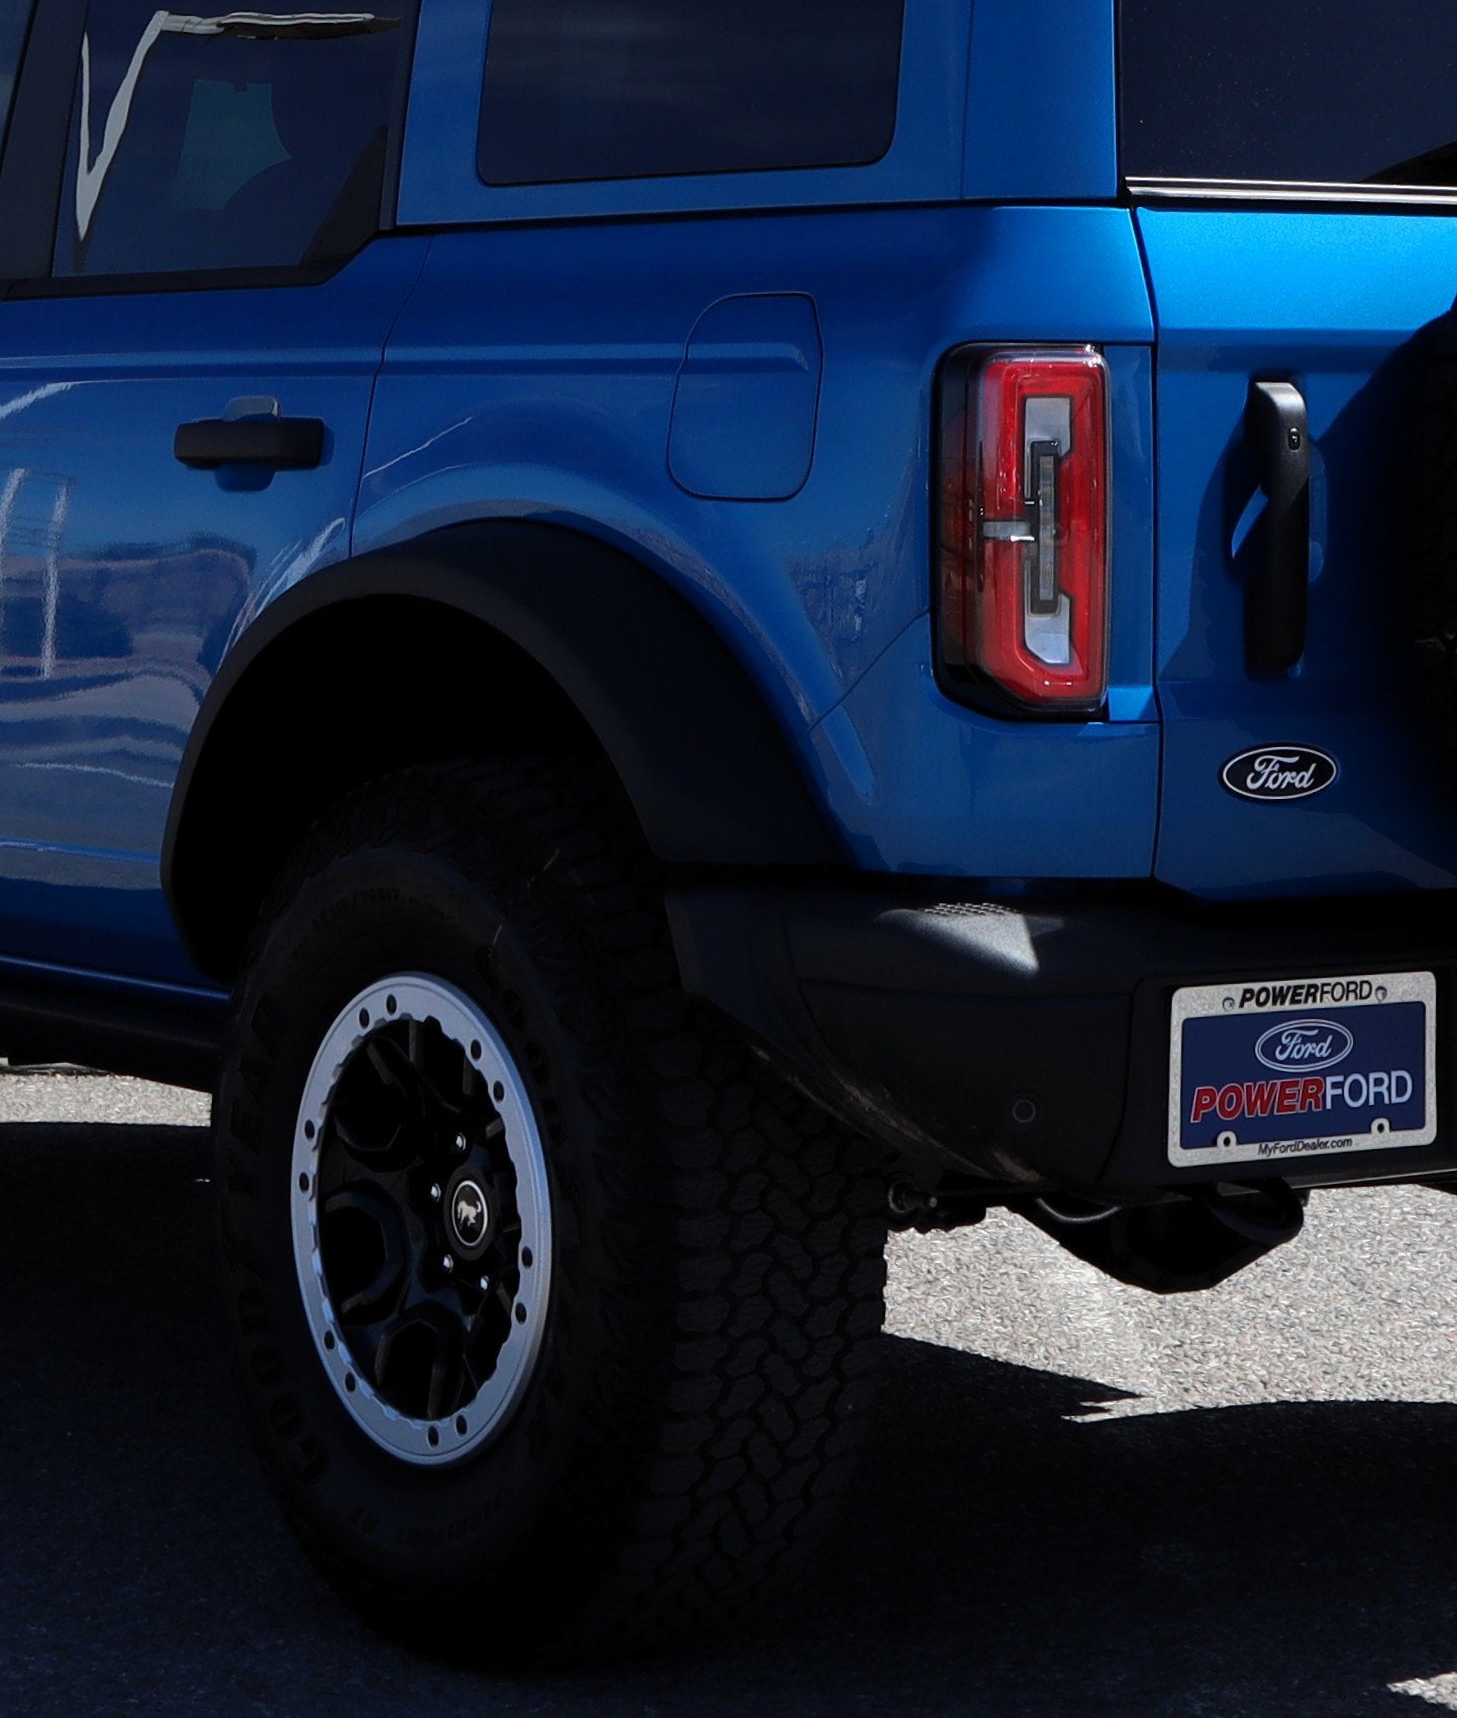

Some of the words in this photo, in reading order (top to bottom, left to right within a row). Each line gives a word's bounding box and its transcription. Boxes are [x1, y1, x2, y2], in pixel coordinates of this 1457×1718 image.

[1246, 754, 1316, 791] Ford
[1238, 980, 1373, 1009] POWERFORD
[1274, 1027, 1334, 1062] Ford
[1189, 1069, 1414, 1123] POWERFORD
[1257, 1137, 1353, 1158] MyFordDealer.com
